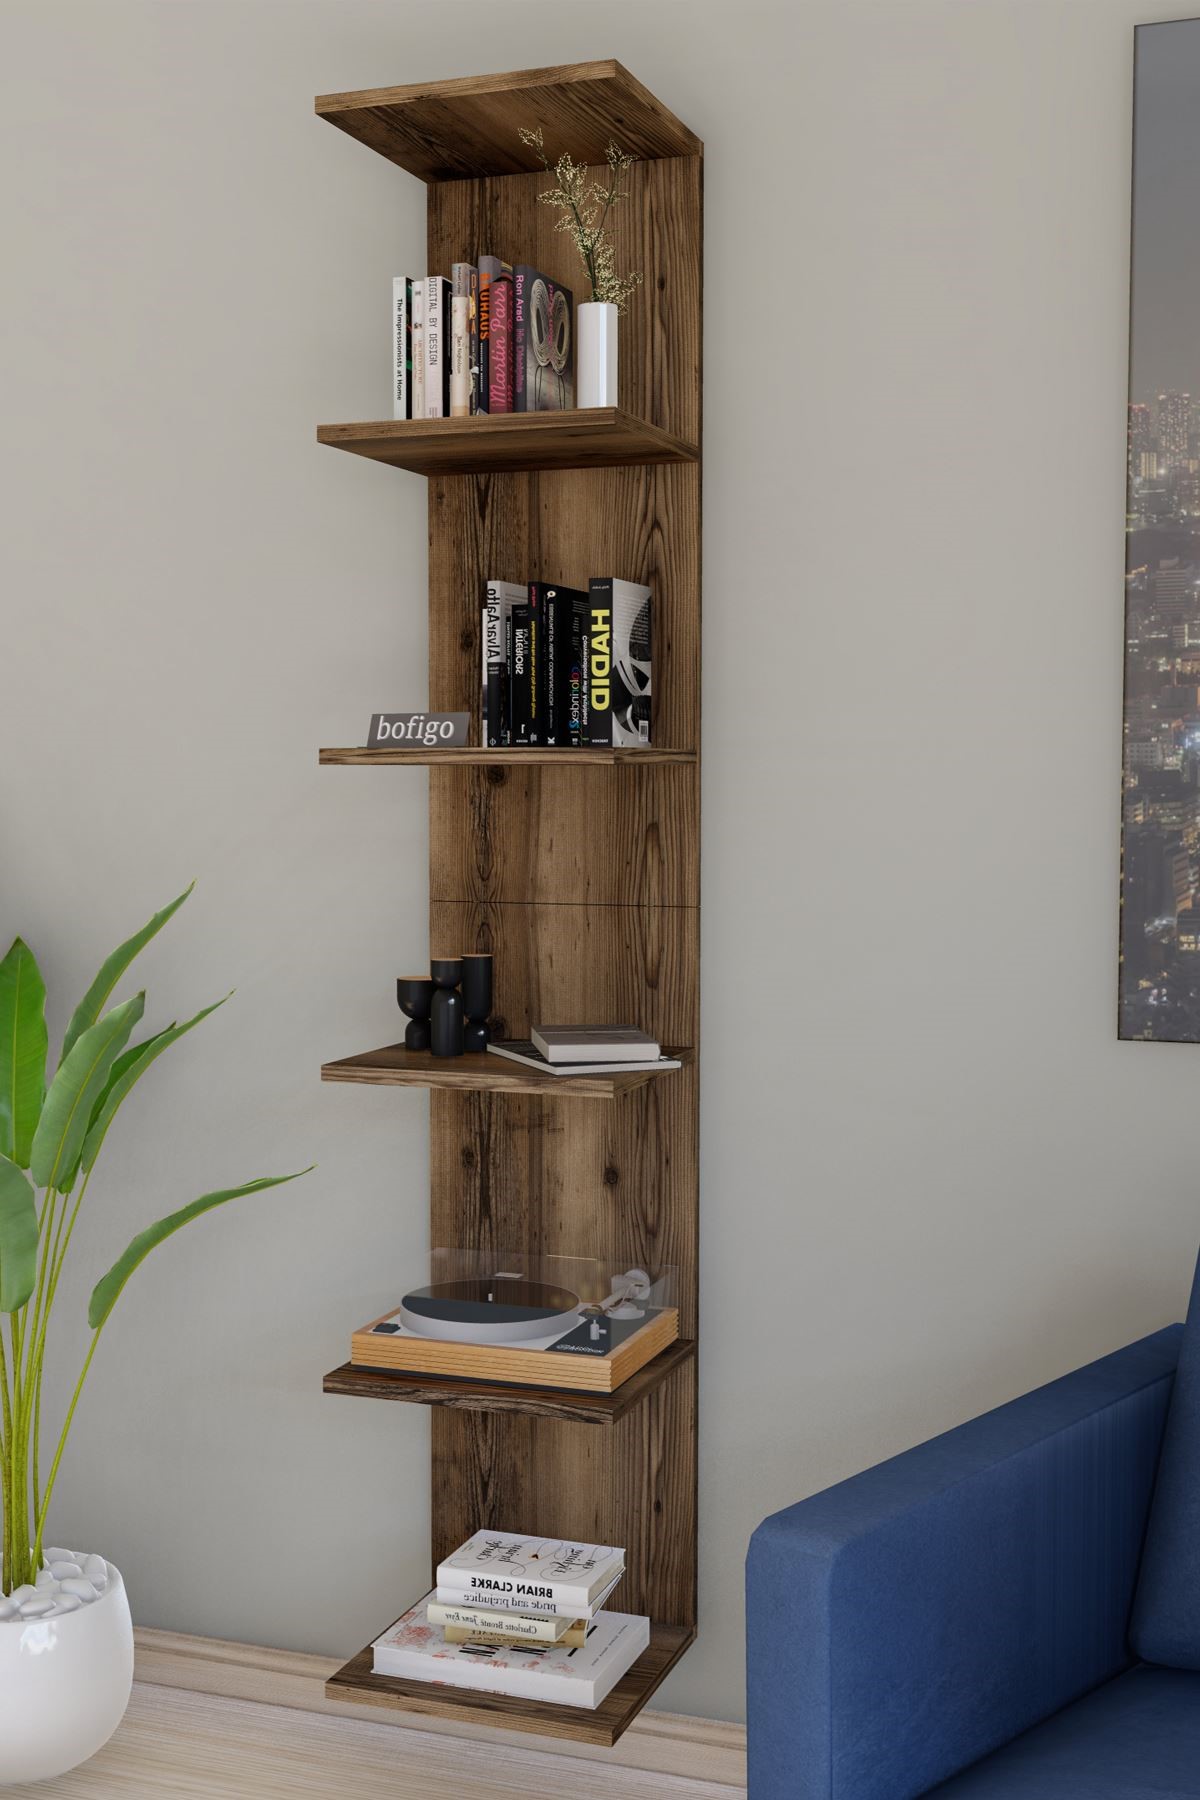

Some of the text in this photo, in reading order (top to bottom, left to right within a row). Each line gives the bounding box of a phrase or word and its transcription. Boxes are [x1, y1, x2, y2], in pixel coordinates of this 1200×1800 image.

[480, 272, 490, 341] BAUHAUS
[516, 275, 525, 296] Ron
[516, 299, 524, 322] Arad
[429, 278, 438, 365] DIGITAL BY DESIGN
[490, 284, 506, 403] Martin Parr
[376, 715, 455, 746] bofigo
